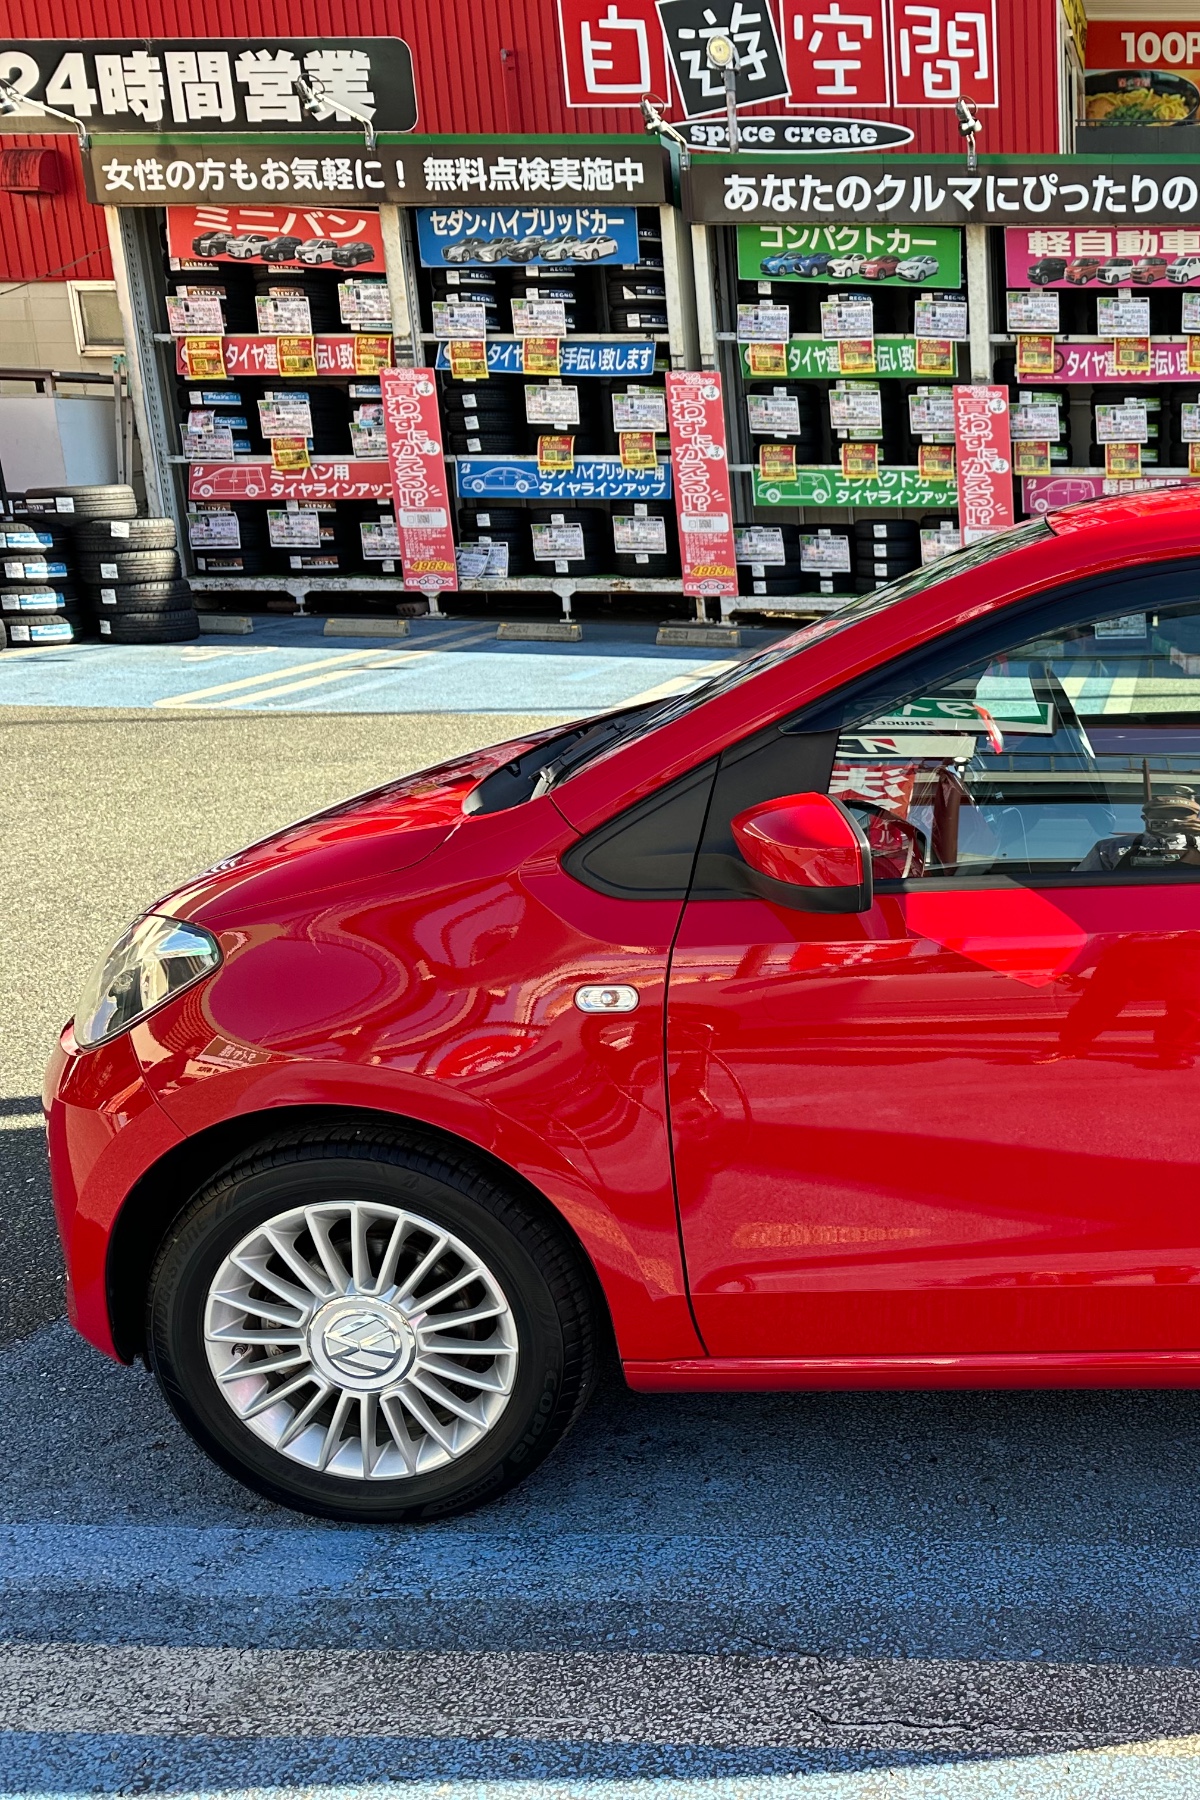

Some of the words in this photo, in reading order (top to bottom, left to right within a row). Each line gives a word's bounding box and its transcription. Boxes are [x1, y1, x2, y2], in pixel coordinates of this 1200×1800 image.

[581, 2, 988, 98] 自遊空間
[1, 49, 378, 124] 24時間営業
[690, 123, 776, 146] space
[784, 122, 878, 145] create
[424, 155, 645, 192] 無料点検実施中
[194, 206, 367, 239] ミニバン
[429, 209, 625, 237] セダン・ハイブリッドカー
[759, 225, 938, 254] コンパクトカー
[538, 481, 666, 497] タイヤラインアップ
